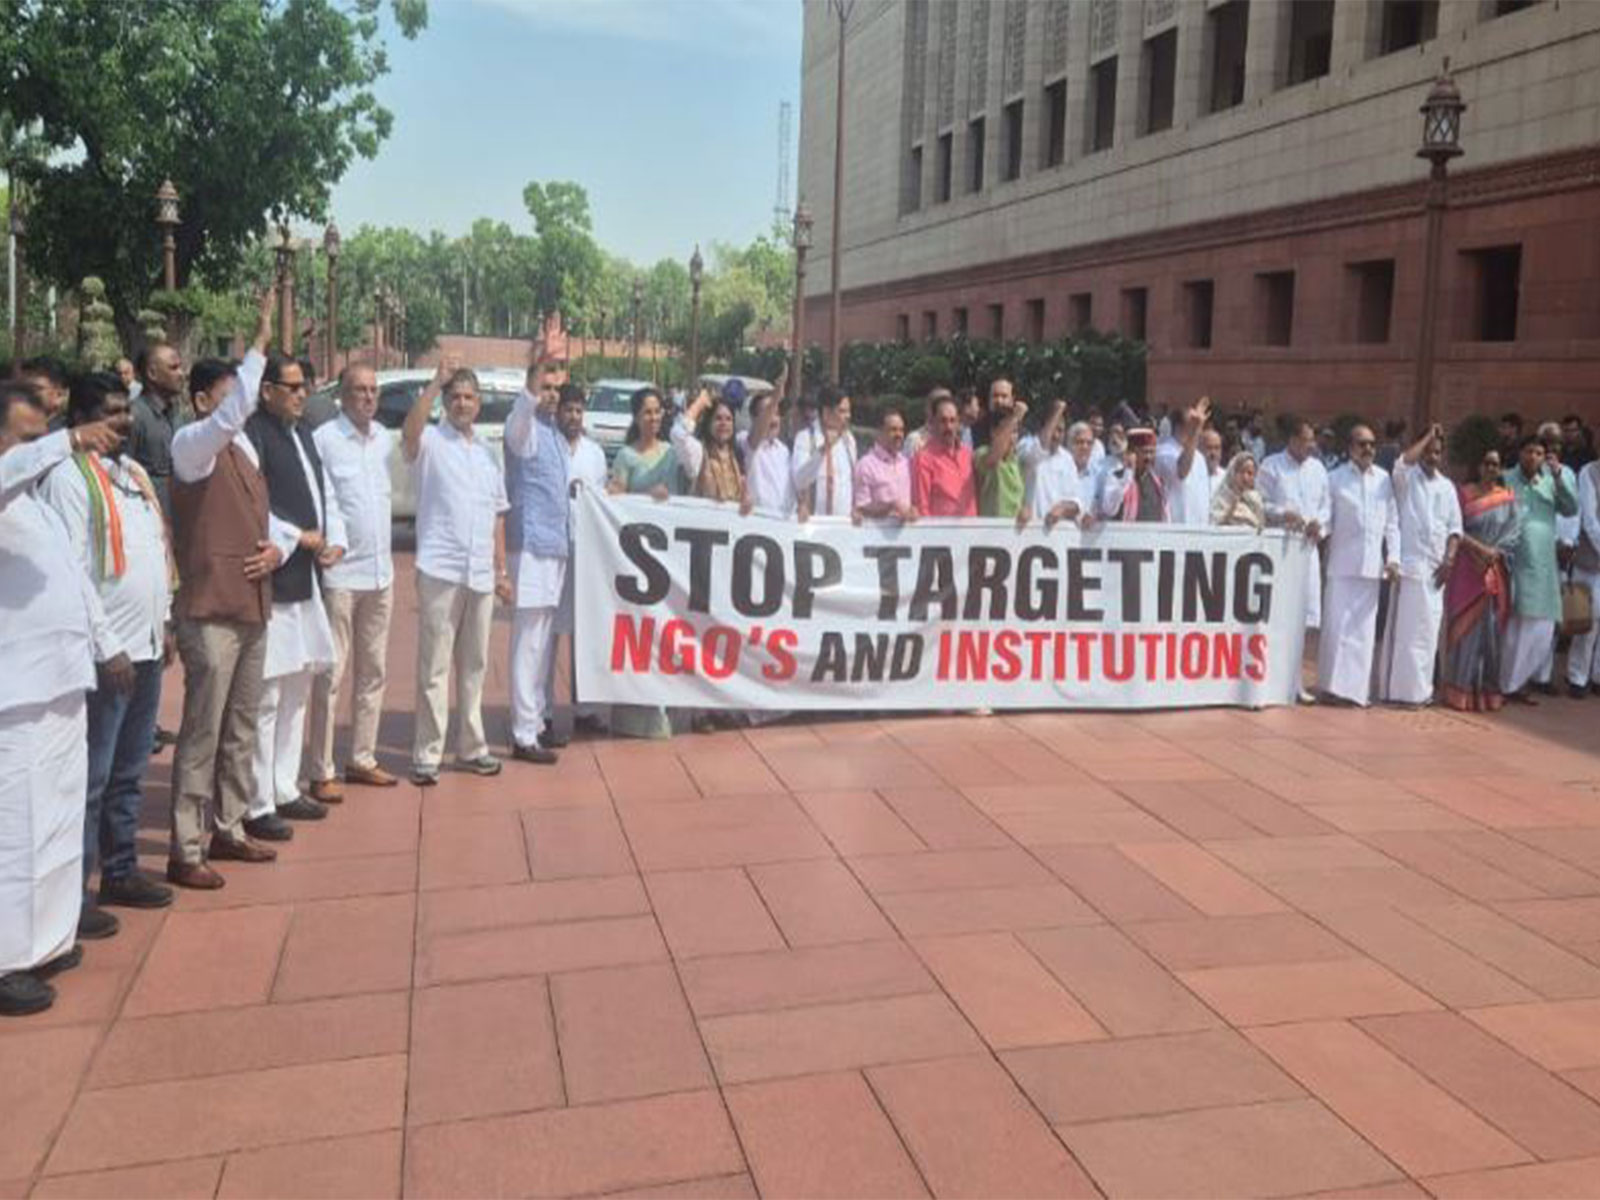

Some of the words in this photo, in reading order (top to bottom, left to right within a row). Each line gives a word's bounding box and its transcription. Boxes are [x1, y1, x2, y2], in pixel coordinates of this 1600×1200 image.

[615, 523, 842, 619] STOP
[864, 545, 1274, 624] TARGETING
[611, 614, 799, 682] NGO'S
[811, 632, 925, 682] AND
[937, 630, 1267, 682] INSTITUTIONS
